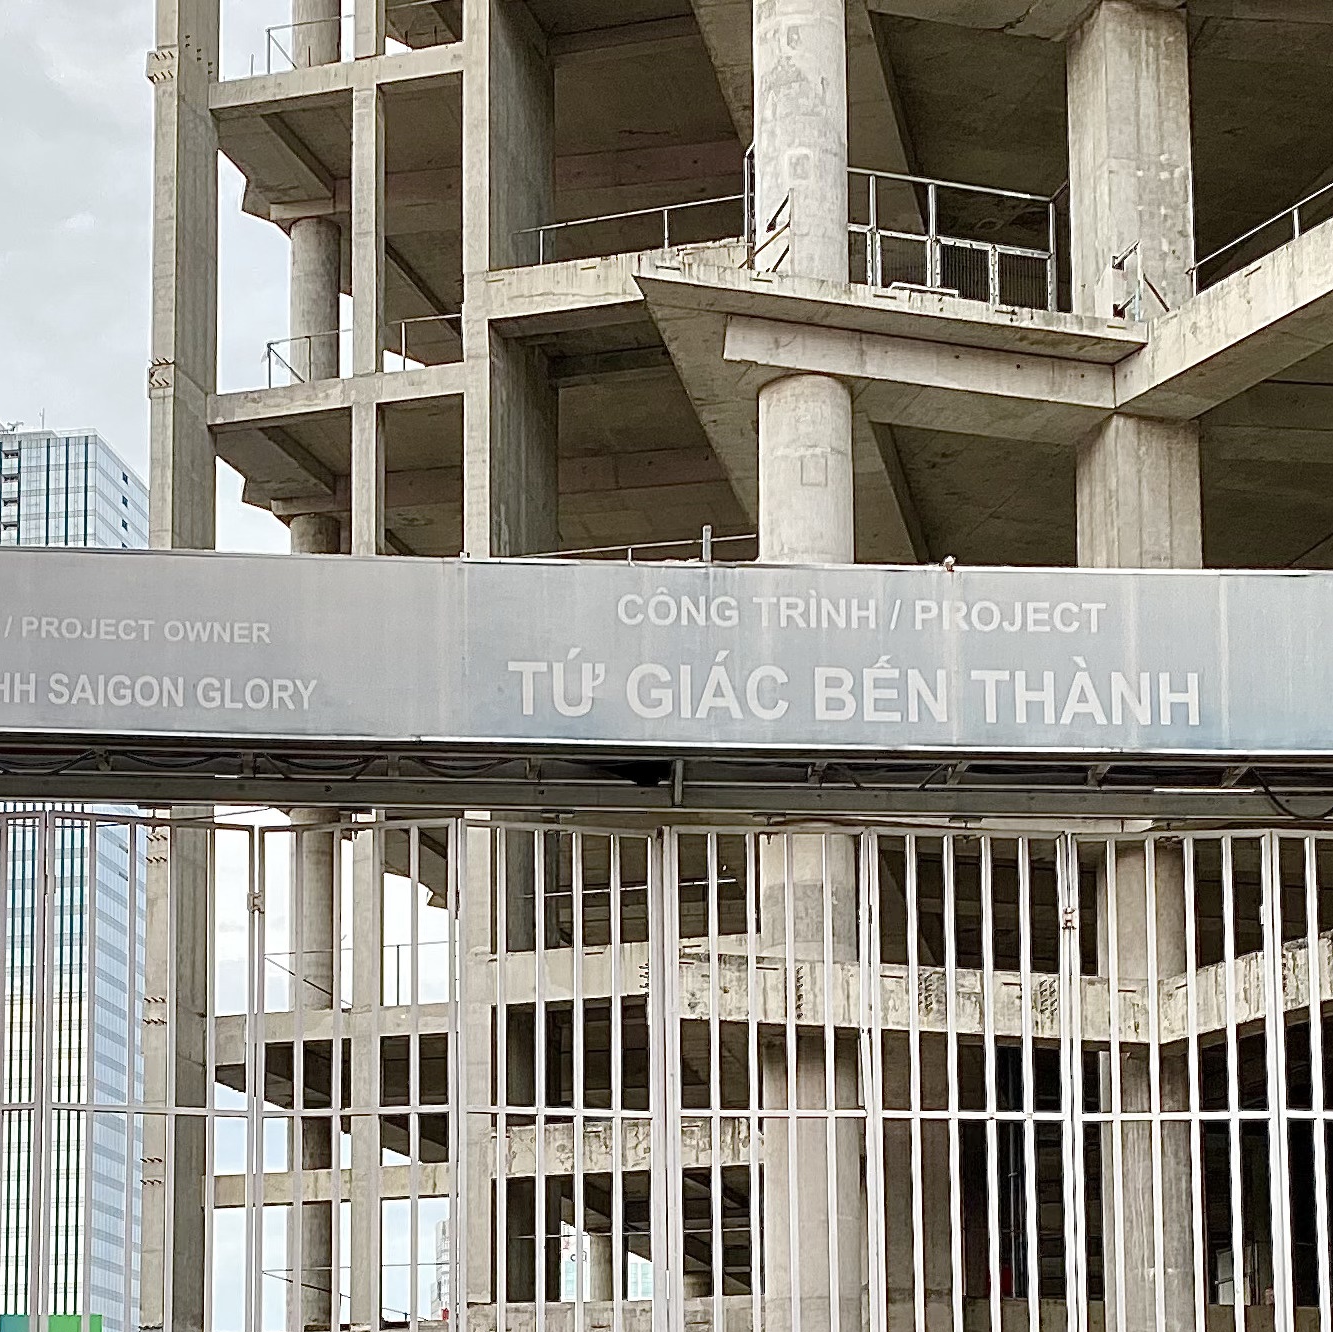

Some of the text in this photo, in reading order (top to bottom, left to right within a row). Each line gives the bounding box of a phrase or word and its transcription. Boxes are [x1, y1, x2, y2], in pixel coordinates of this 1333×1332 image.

[4, 615, 13, 639] /
[20, 616, 154, 642] PROJECT
[163, 620, 272, 644] OWNER
[616, 588, 1109, 635] CÔNG TRÌNH / PROJECT
[47, 674, 187, 709] SAIGON
[194, 677, 319, 712] GLORY
[507, 647, 1201, 727] TỨ GIÁC BẾN THÀNH
